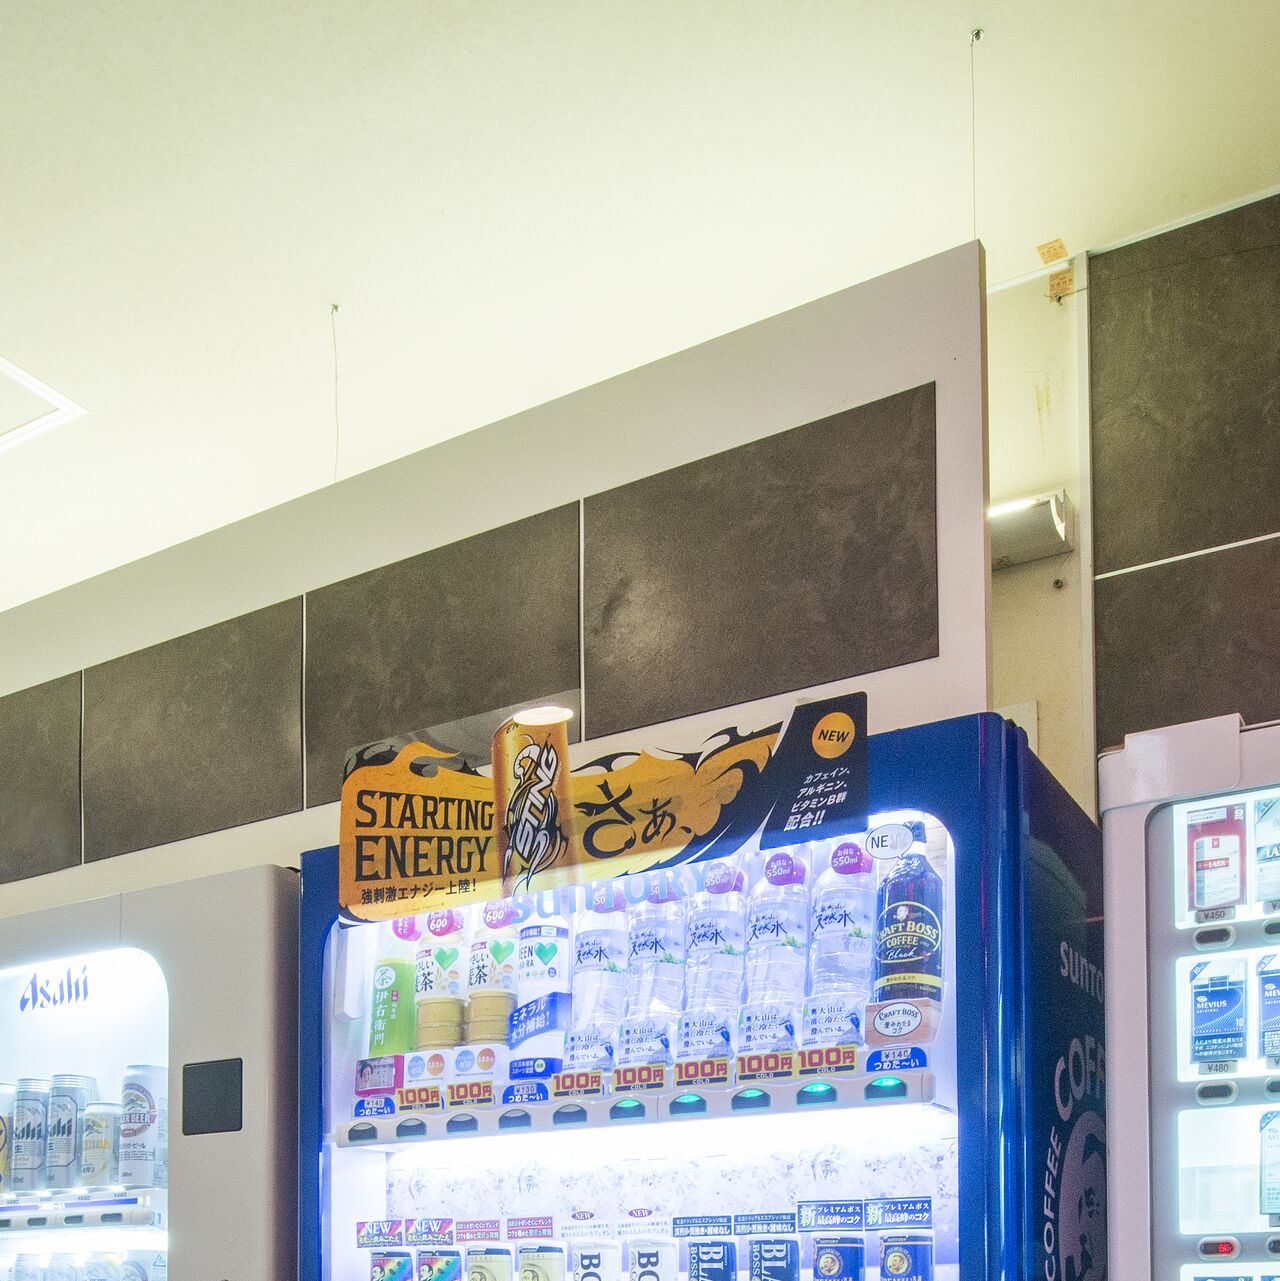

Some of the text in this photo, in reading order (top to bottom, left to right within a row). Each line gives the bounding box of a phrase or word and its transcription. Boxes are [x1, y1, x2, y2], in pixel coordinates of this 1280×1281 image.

[818, 725, 851, 744] NEW
[355, 788, 495, 830] STARTING
[355, 832, 493, 882] ENERGY
[361, 880, 477, 906] 強刺激エナジー上陸!
[906, 919, 939, 940] BOSS
[886, 936, 919, 948] COFFEE
[20, 964, 90, 1013] Asahi
[737, 1055, 793, 1075] 100円
[798, 1049, 856, 1069] 100円
[675, 1060, 728, 1080] 100円
